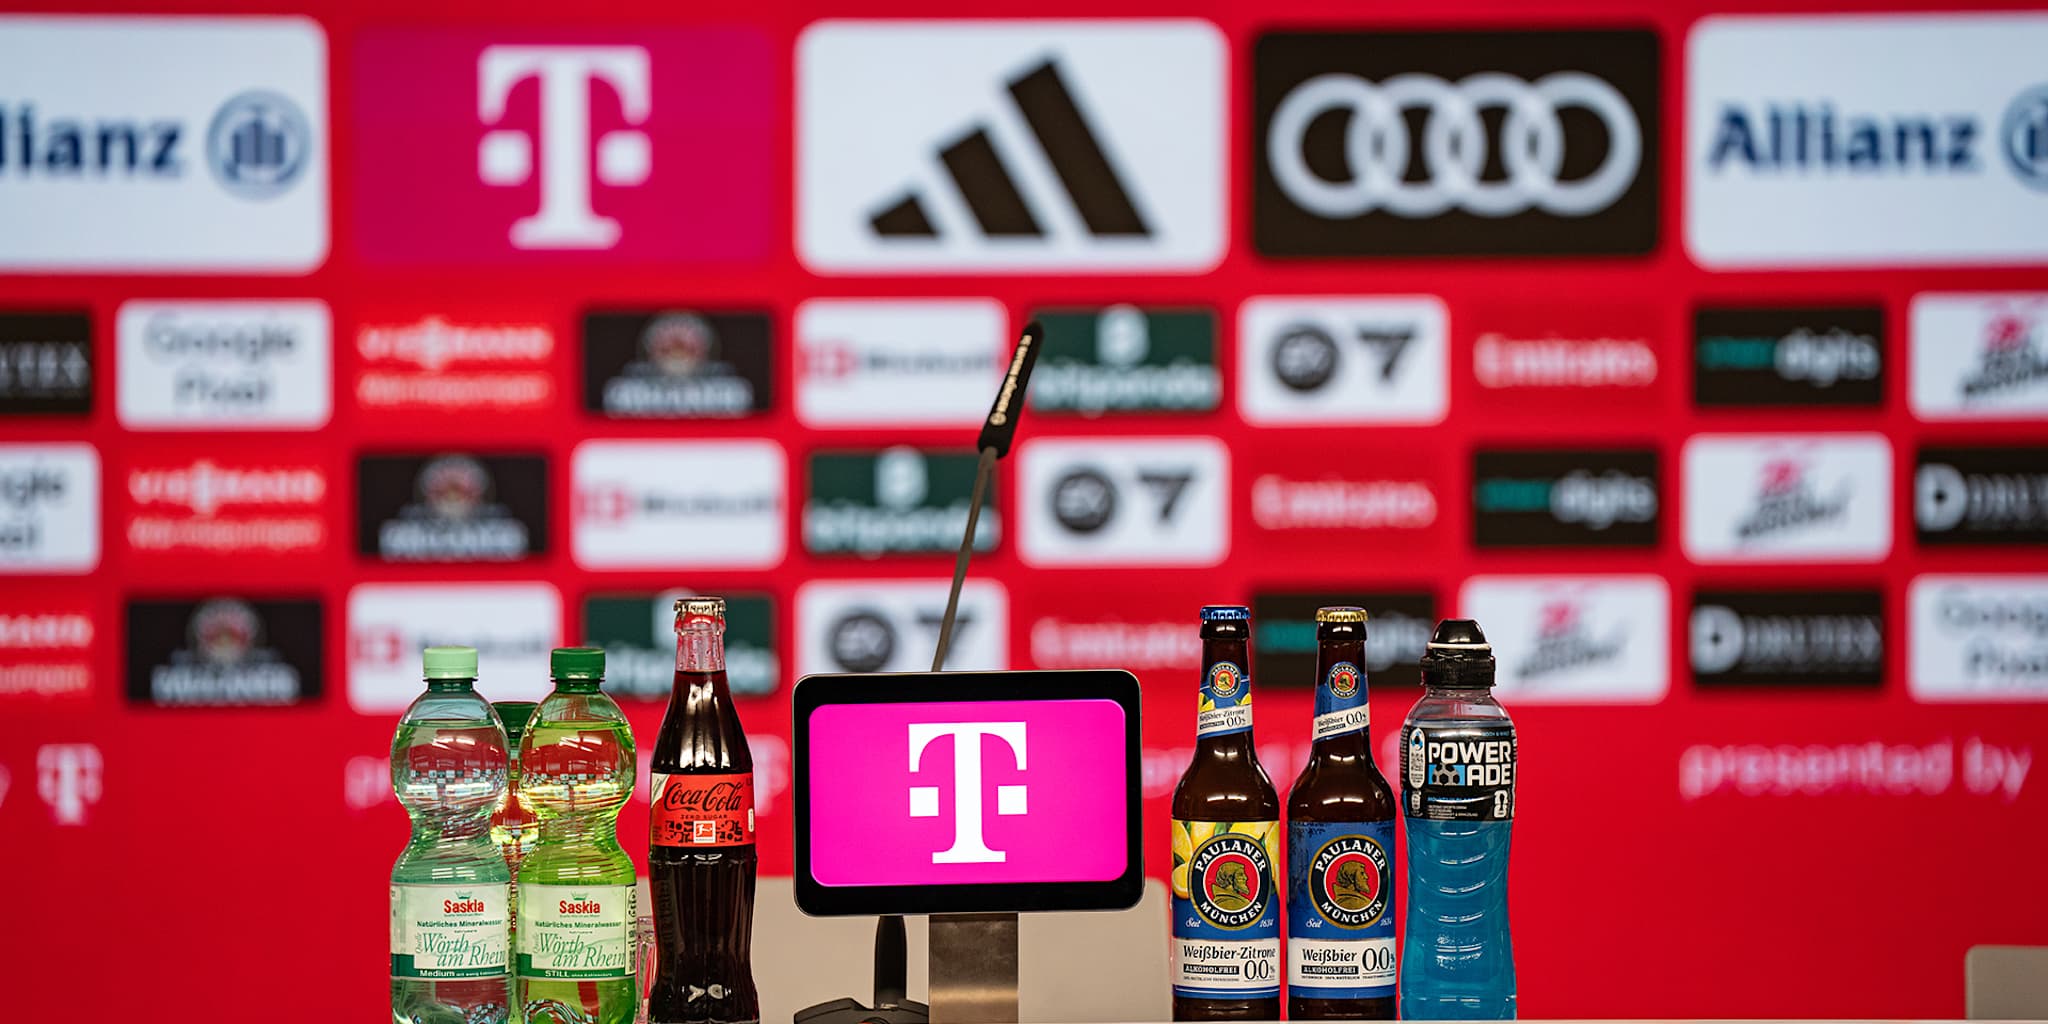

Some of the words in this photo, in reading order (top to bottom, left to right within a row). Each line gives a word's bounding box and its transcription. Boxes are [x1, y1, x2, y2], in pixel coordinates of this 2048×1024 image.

[476, 44, 652, 250] T
[1709, 99, 1982, 175] Allianz
[1474, 334, 1657, 388] Emirates
[1252, 475, 1437, 530] Emirates
[1428, 741, 1511, 763] POWER
[1467, 763, 1511, 786] ADE
[1680, 744, 1953, 802] presented
[1963, 737, 2032, 804] by
[664, 782, 743, 812] Coca-Cola
[908, 721, 1028, 864] T
[1195, 840, 1268, 873] PAULANER
[1314, 840, 1388, 873] PAULANER
[444, 899, 485, 914] Saskia
[559, 900, 600, 915] Saskia
[1200, 901, 1263, 926] MÜNCHEN
[1321, 900, 1383, 925] MÜNCHEN
[417, 920, 457, 928] Natürliches
[459, 919, 503, 928] Mineralwasser
[535, 921, 573, 929] Natürliches
[574, 921, 621, 929] Mineralwasser
[1185, 917, 1202, 928] Seit
[1305, 918, 1323, 928] Seit
[422, 932, 469, 954] Wörth
[539, 932, 584, 954] Wörth
[1183, 945, 1276, 962] Weißbier-Zitrone
[437, 953, 464, 967] am
[469, 943, 505, 967] Rhein
[552, 953, 578, 967] am
[584, 944, 625, 968] Rhein
[1302, 949, 1358, 965] Weißbier
[420, 969, 455, 977] Medium
[1185, 965, 1238, 973] ALKOHOLFREI
[1303, 966, 1357, 974] ALKOHOLFREI
